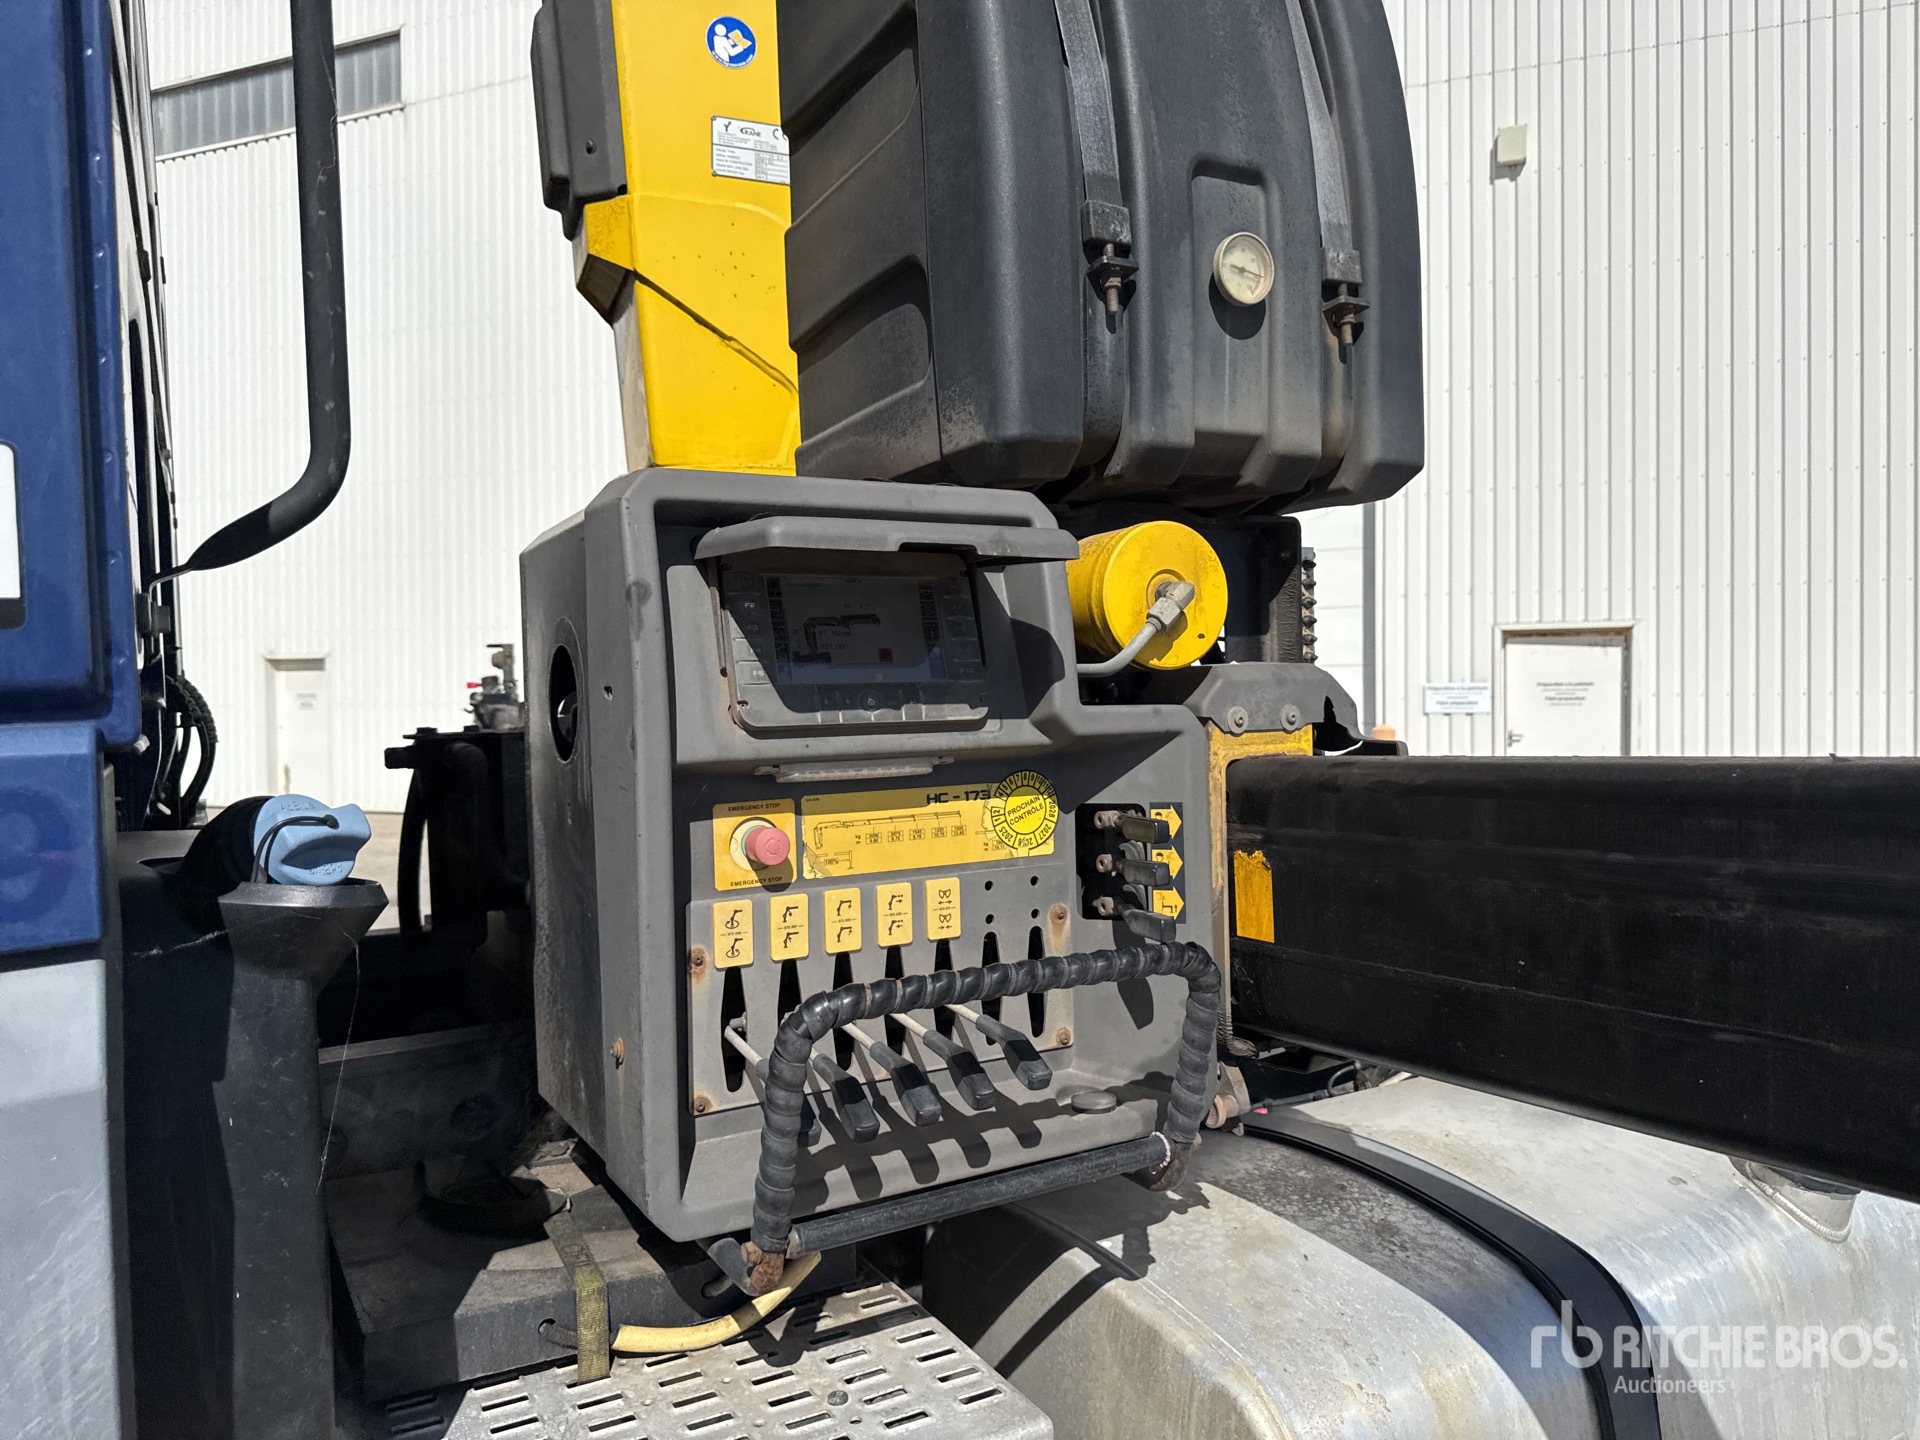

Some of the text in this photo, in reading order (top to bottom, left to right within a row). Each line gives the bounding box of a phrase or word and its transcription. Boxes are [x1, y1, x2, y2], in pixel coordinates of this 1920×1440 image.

[1016, 773, 1020, 782] 7
[1030, 773, 1035, 781] 9
[1036, 776, 1043, 784] 10
[1042, 781, 1049, 789] 11
[927, 792, 949, 804] HC
[964, 790, 991, 801] 173
[728, 803, 764, 812] EMERGENCY
[1007, 795, 1041, 817] PROCHAIN
[1009, 802, 1045, 826] CONTRÔLE
[998, 826, 1014, 842] 2025
[1039, 824, 1052, 840] 2027
[730, 878, 767, 887] EMERGENCY
